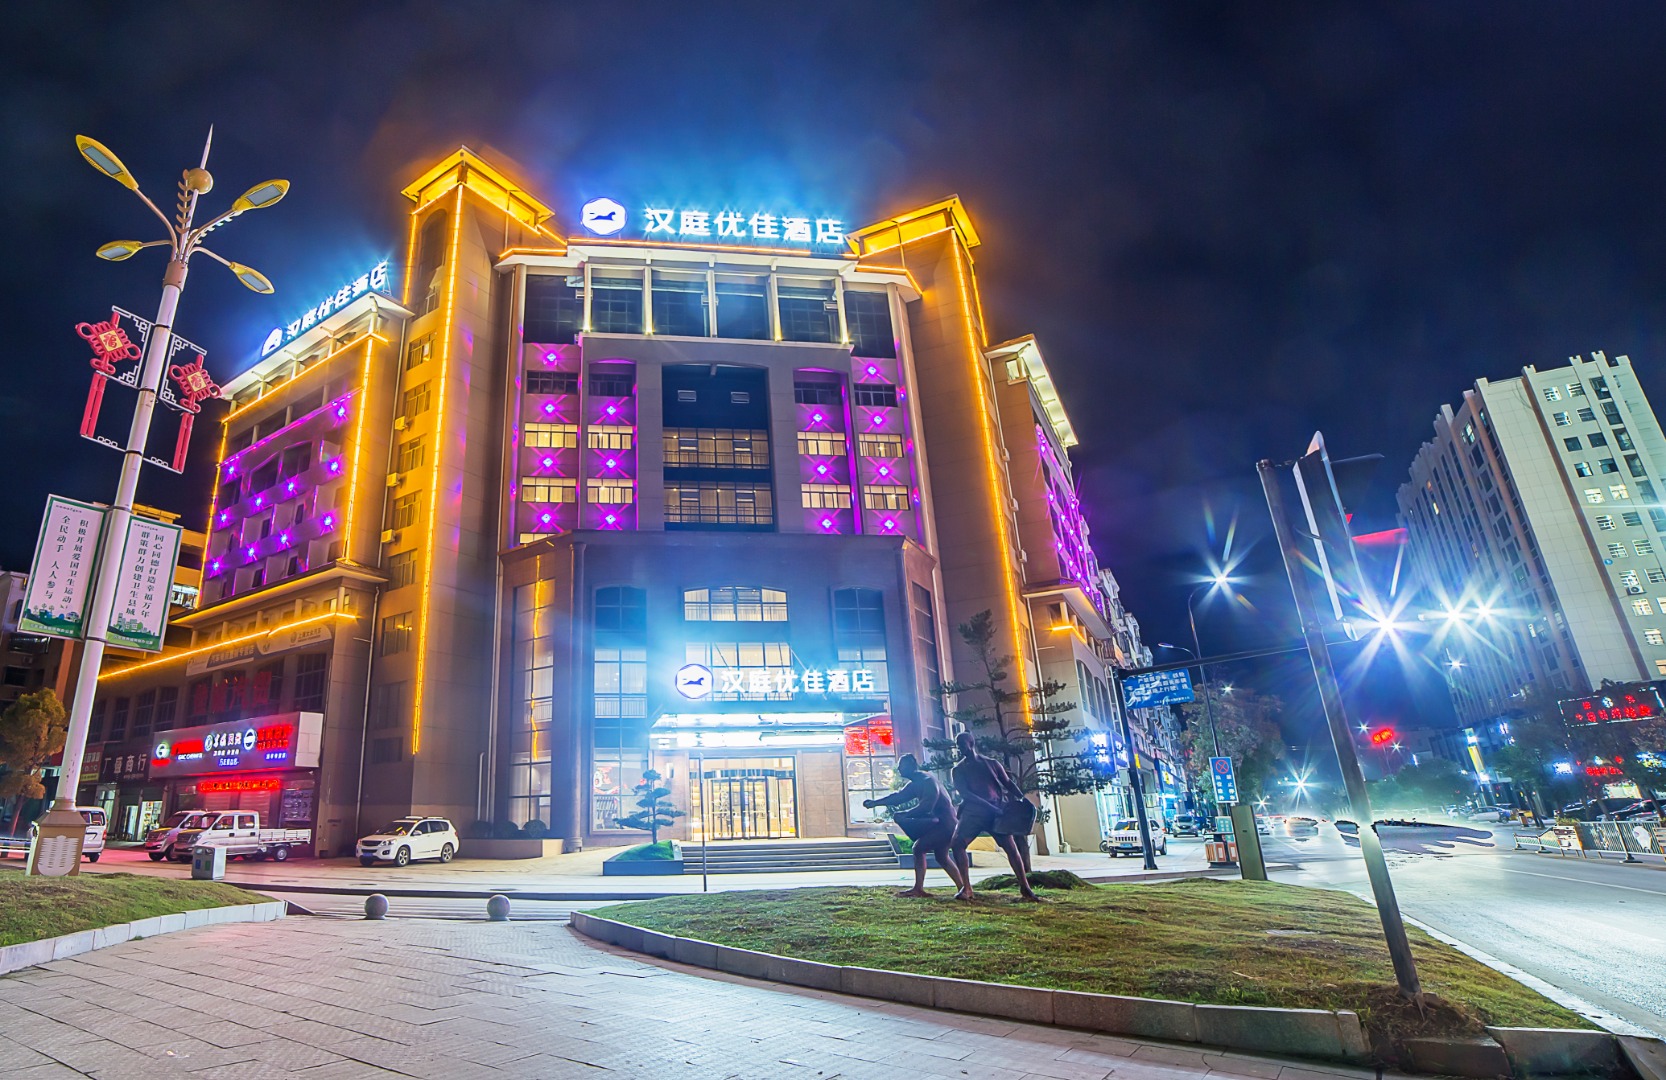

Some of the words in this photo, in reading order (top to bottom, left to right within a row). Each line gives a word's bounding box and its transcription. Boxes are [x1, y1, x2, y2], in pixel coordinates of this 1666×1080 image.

[645, 208, 844, 243] 汉庭优佳酒店
[62, 519, 89, 604] 积极开展爱国卫生运动
[126, 531, 150, 616] 群策群力创建卫生县城
[141, 533, 164, 618] 同心同德打造幸福万年
[720, 669, 875, 694] 汉庭优佳酒店
